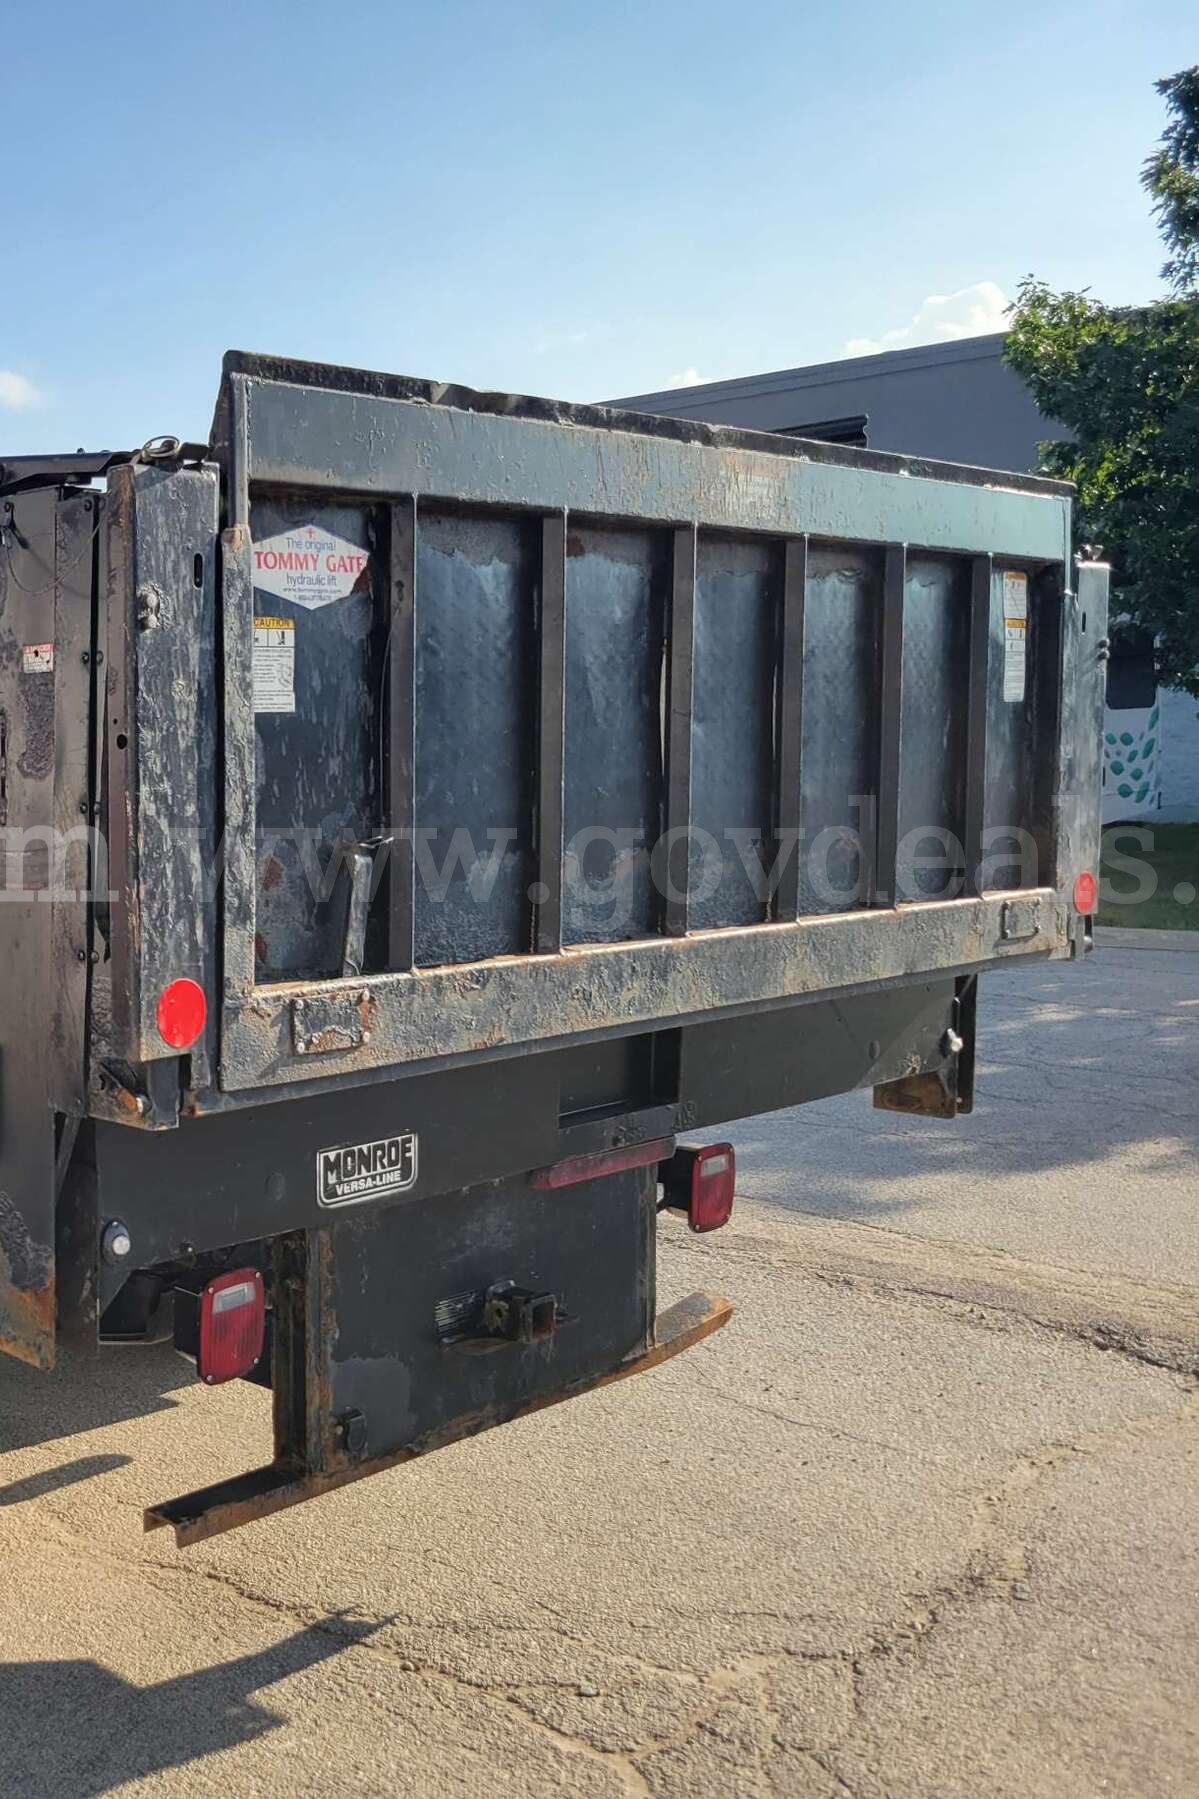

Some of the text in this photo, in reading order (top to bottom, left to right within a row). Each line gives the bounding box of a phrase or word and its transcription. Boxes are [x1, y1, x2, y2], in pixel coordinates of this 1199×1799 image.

[287, 537, 336, 553] The original
[254, 551, 320, 572] TOMMY
[286, 573, 338, 587] hydraulic lift
[322, 1135, 413, 1198] MONROE
[335, 1170, 402, 1196] VERSA-LINE
